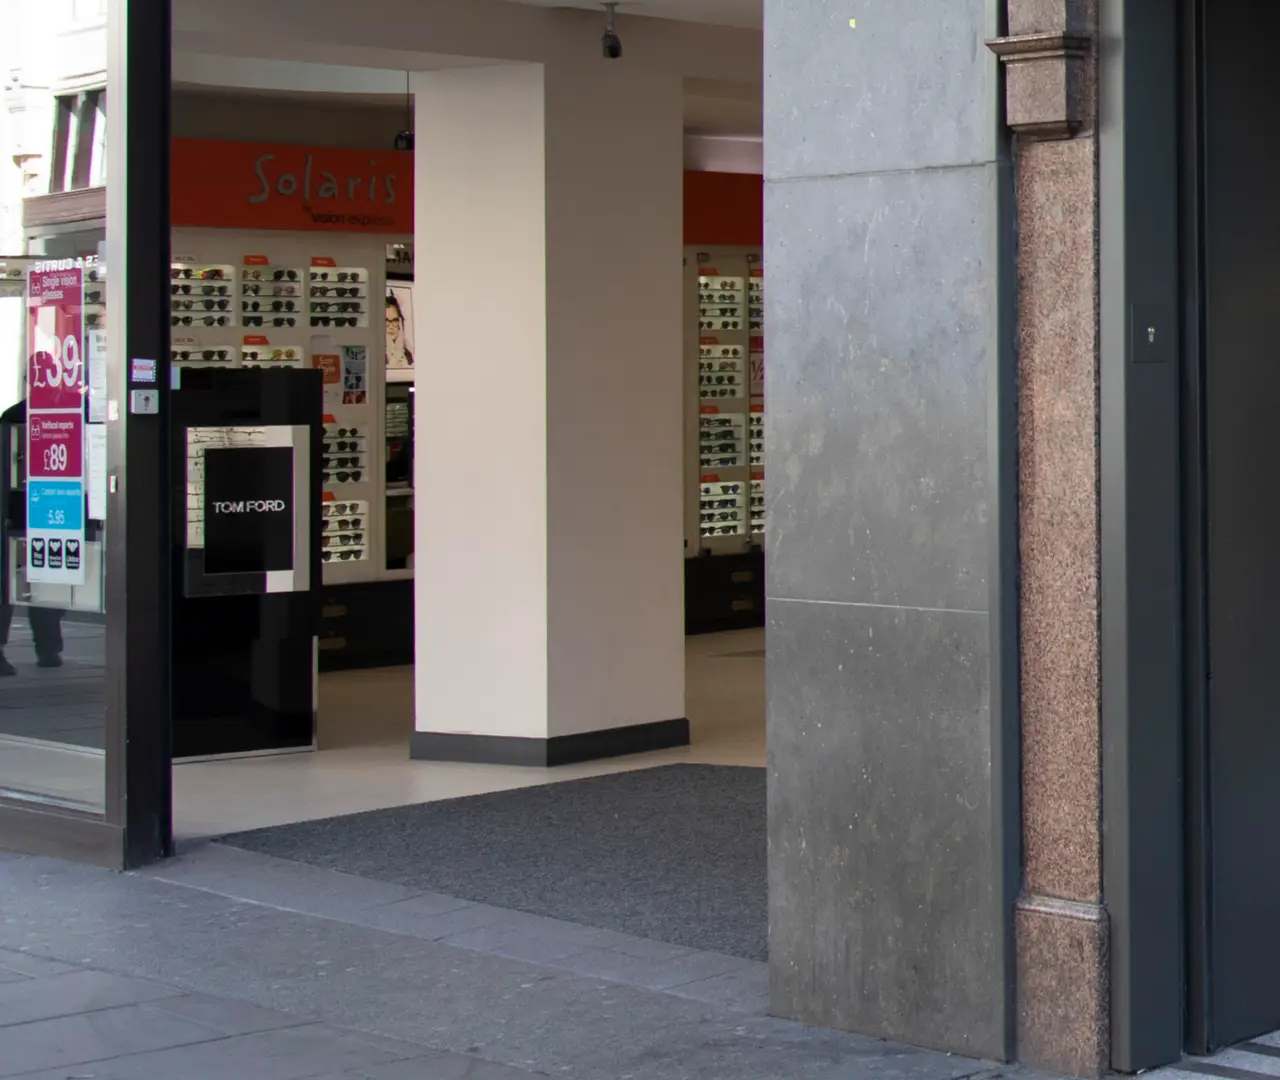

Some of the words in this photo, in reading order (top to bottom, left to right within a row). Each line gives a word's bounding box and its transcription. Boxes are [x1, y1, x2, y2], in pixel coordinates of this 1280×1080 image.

[246, 153, 397, 205] Solaris
[42, 276, 59, 290] Single
[60, 274, 78, 286] vision
[41, 289, 64, 303] glasses
[33, 334, 81, 388] £39
[43, 443, 68, 471] £89
[212, 501, 244, 514] TOM
[245, 499, 285, 512] FORD
